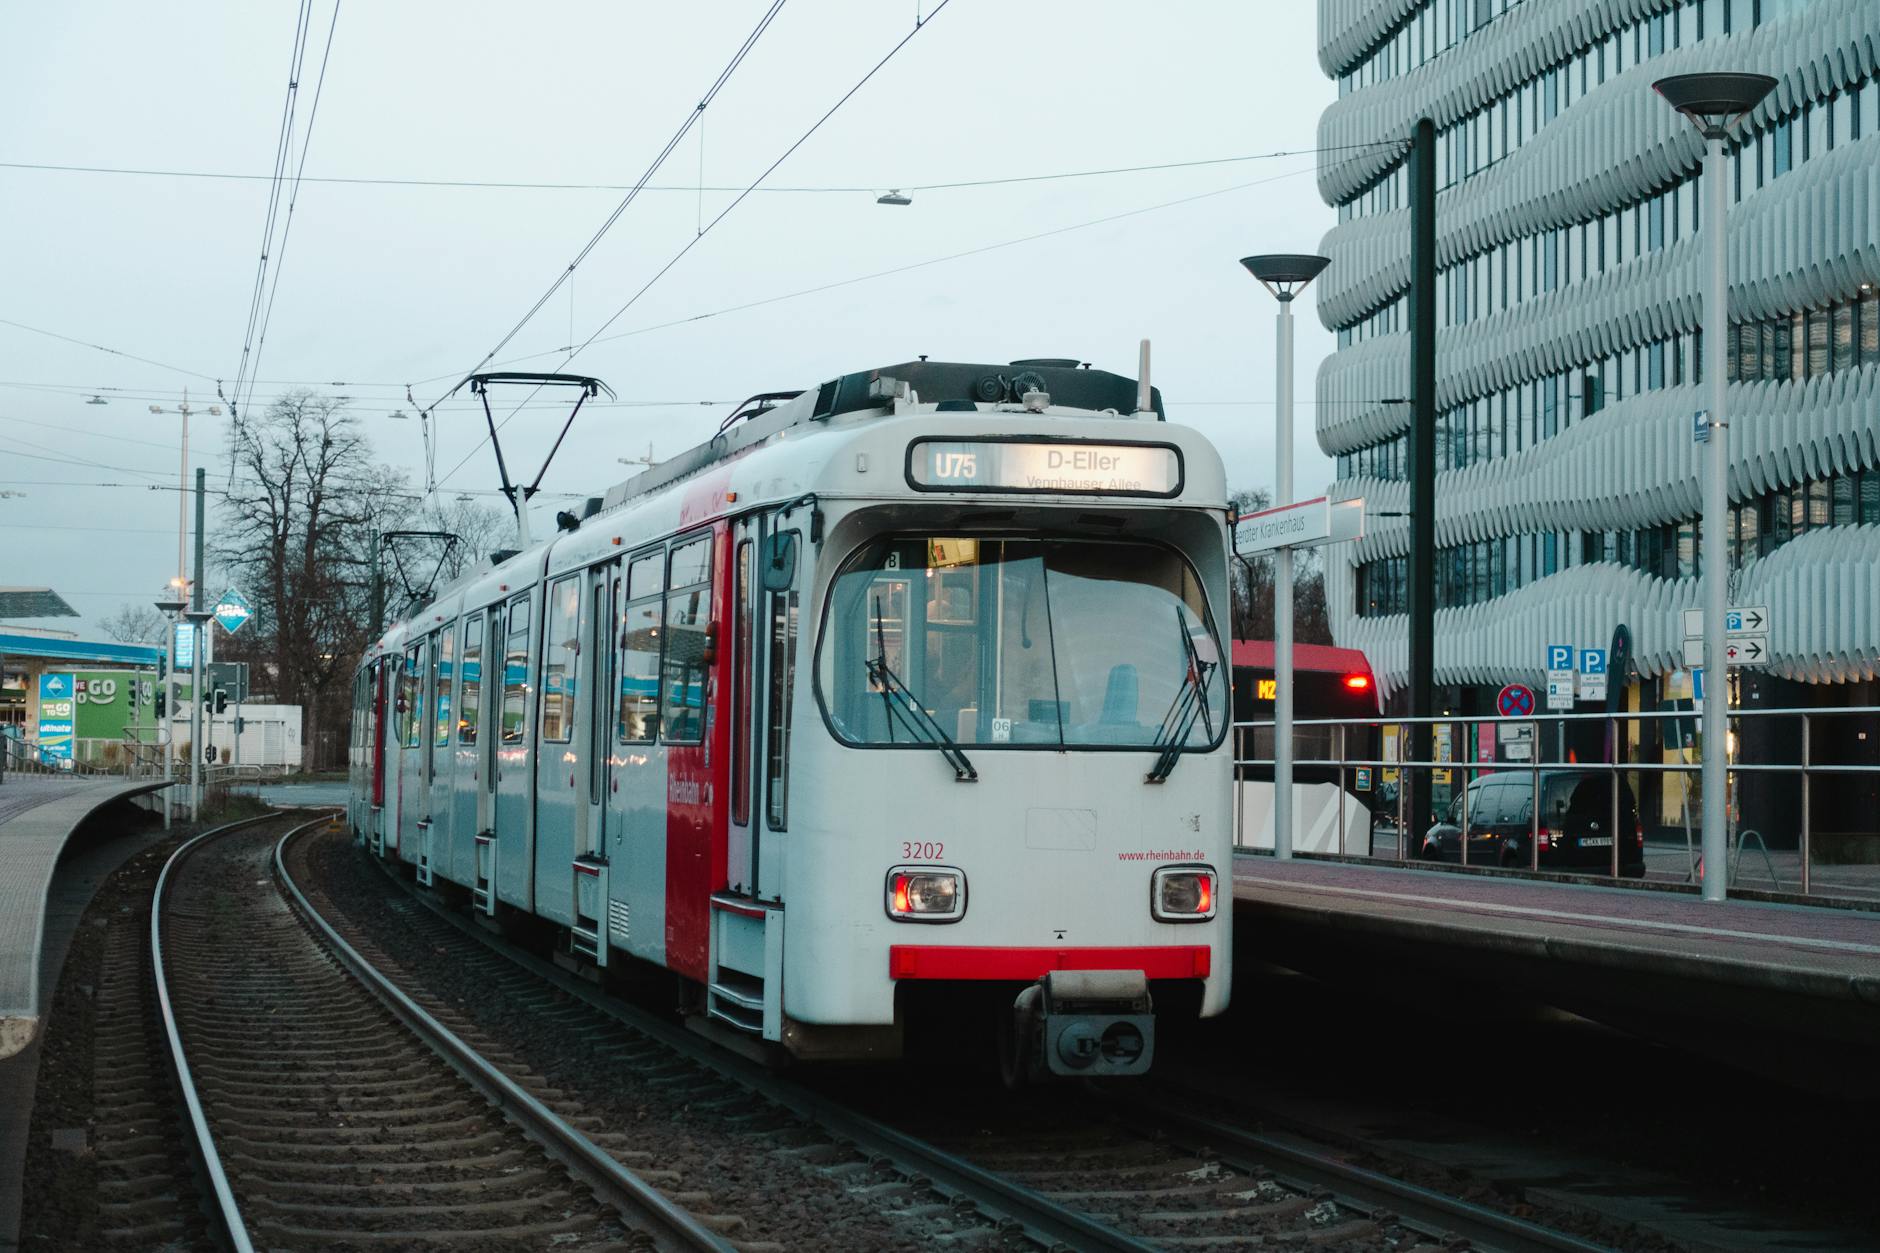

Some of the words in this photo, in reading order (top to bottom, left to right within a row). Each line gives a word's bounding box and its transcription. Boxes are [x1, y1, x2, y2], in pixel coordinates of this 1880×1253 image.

[935, 453, 977, 479] U75
[1047, 450, 1121, 471] D-Eller
[1108, 478, 1142, 491] Allee
[1260, 514, 1305, 539] Krankenhaus
[888, 554, 897, 568] B
[216, 604, 249, 617] ARAL
[1728, 616, 1738, 629] P
[1553, 648, 1568, 669] P
[1585, 651, 1601, 673] P
[88, 679, 116, 695] GO
[55, 703, 70, 711] GO
[994, 721, 1009, 731] 06
[902, 841, 945, 860] 3202
[1118, 848, 1206, 861] www.rheinbahn.de
